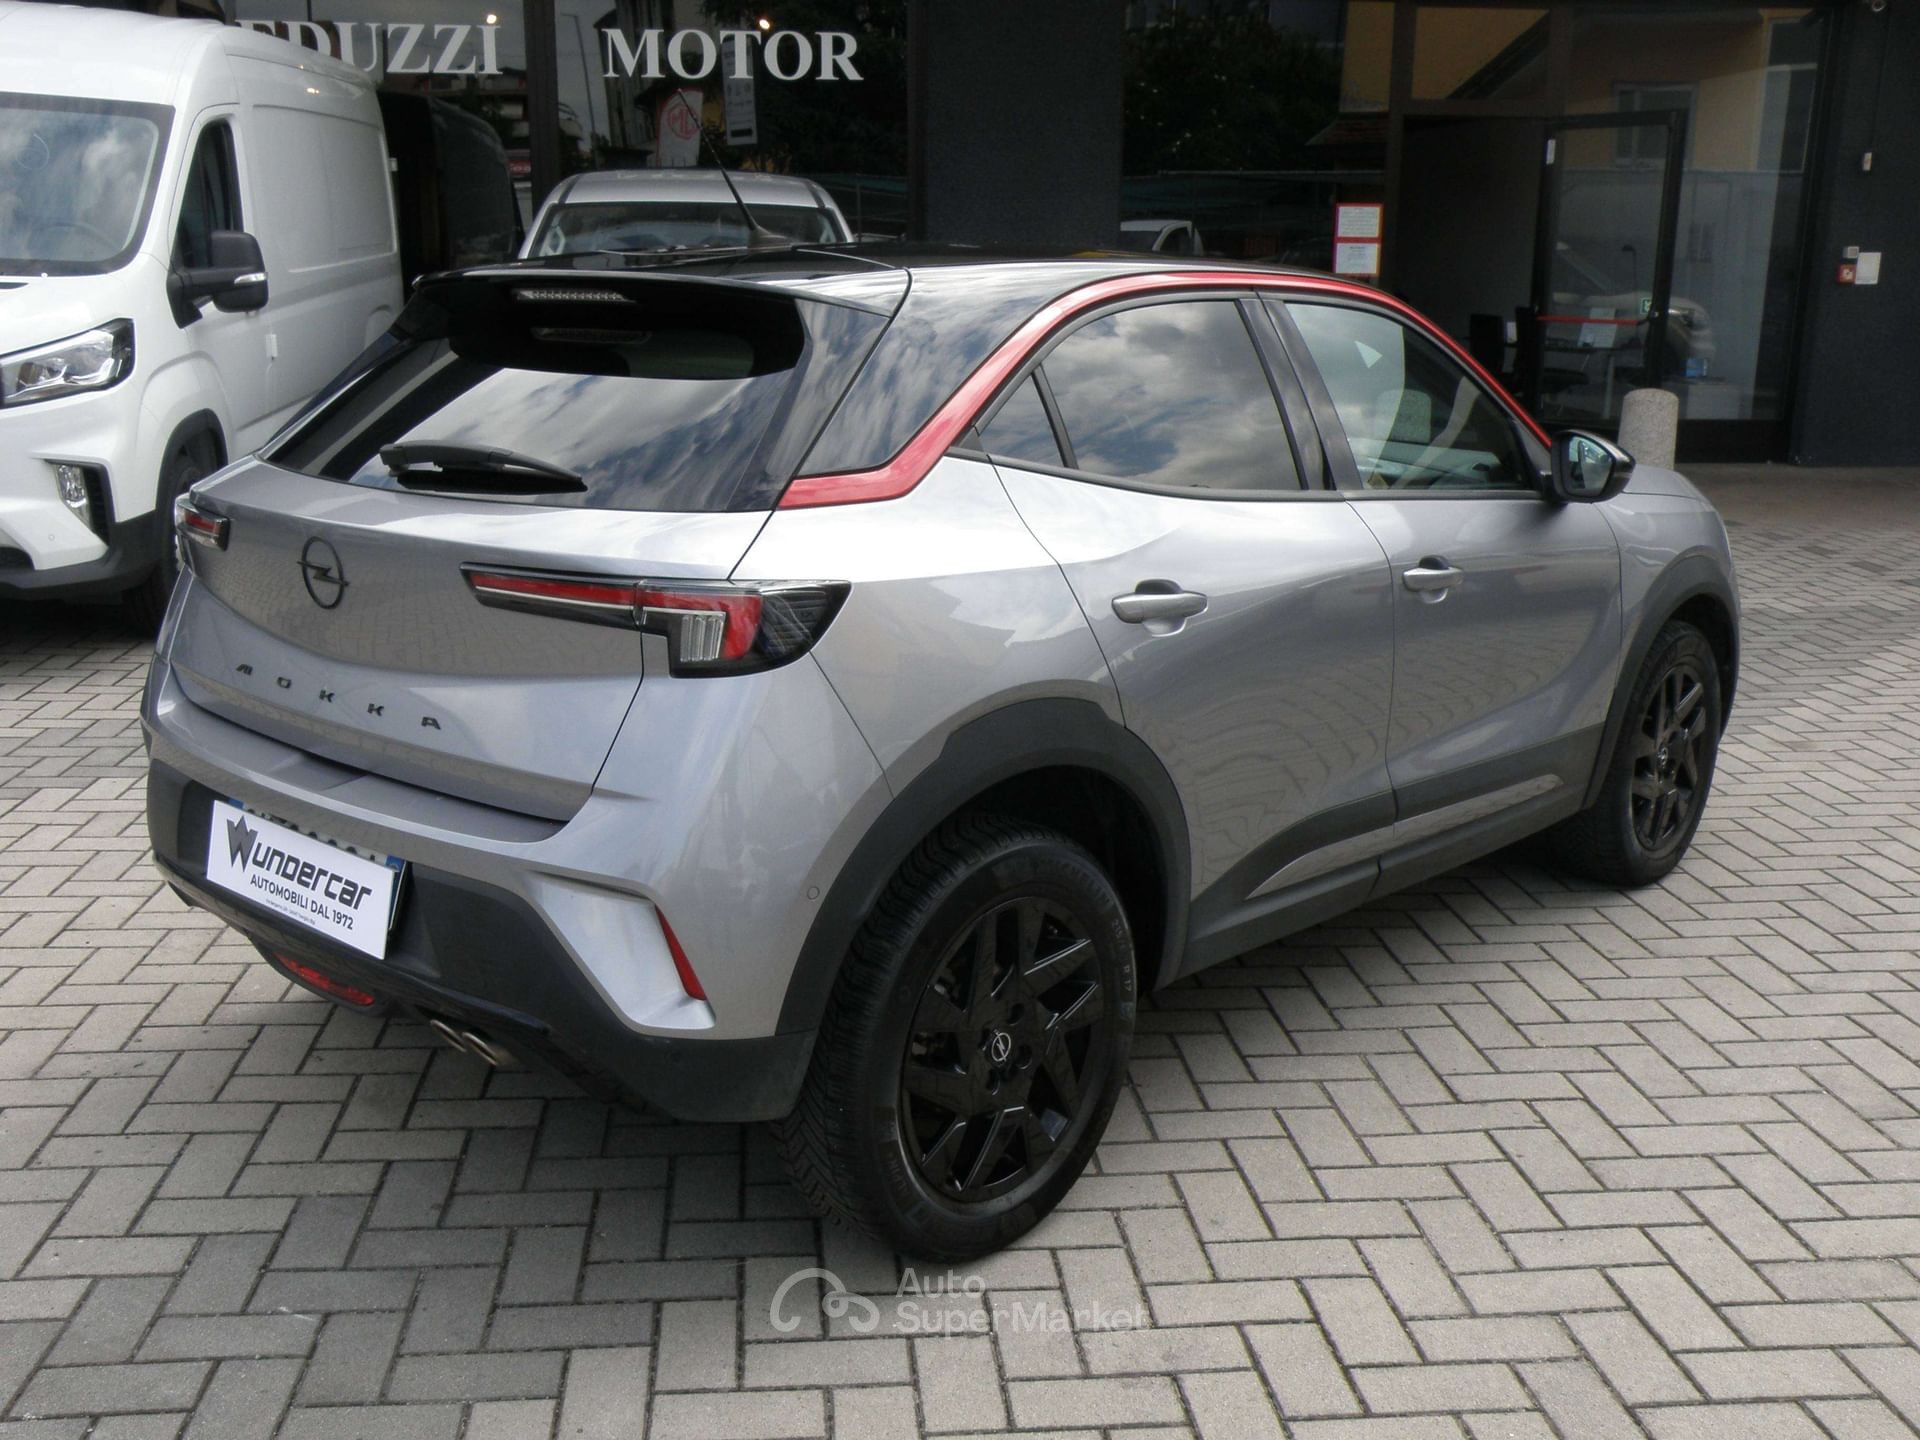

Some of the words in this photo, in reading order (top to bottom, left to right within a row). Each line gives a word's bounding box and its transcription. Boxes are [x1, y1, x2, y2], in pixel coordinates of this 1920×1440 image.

[601, 28, 864, 80] MOTOR
[235, 663, 441, 731] MOKKA
[250, 874, 309, 910] AUTOMOBILI
[310, 900, 330, 921] DAL
[332, 909, 354, 931] 1972
